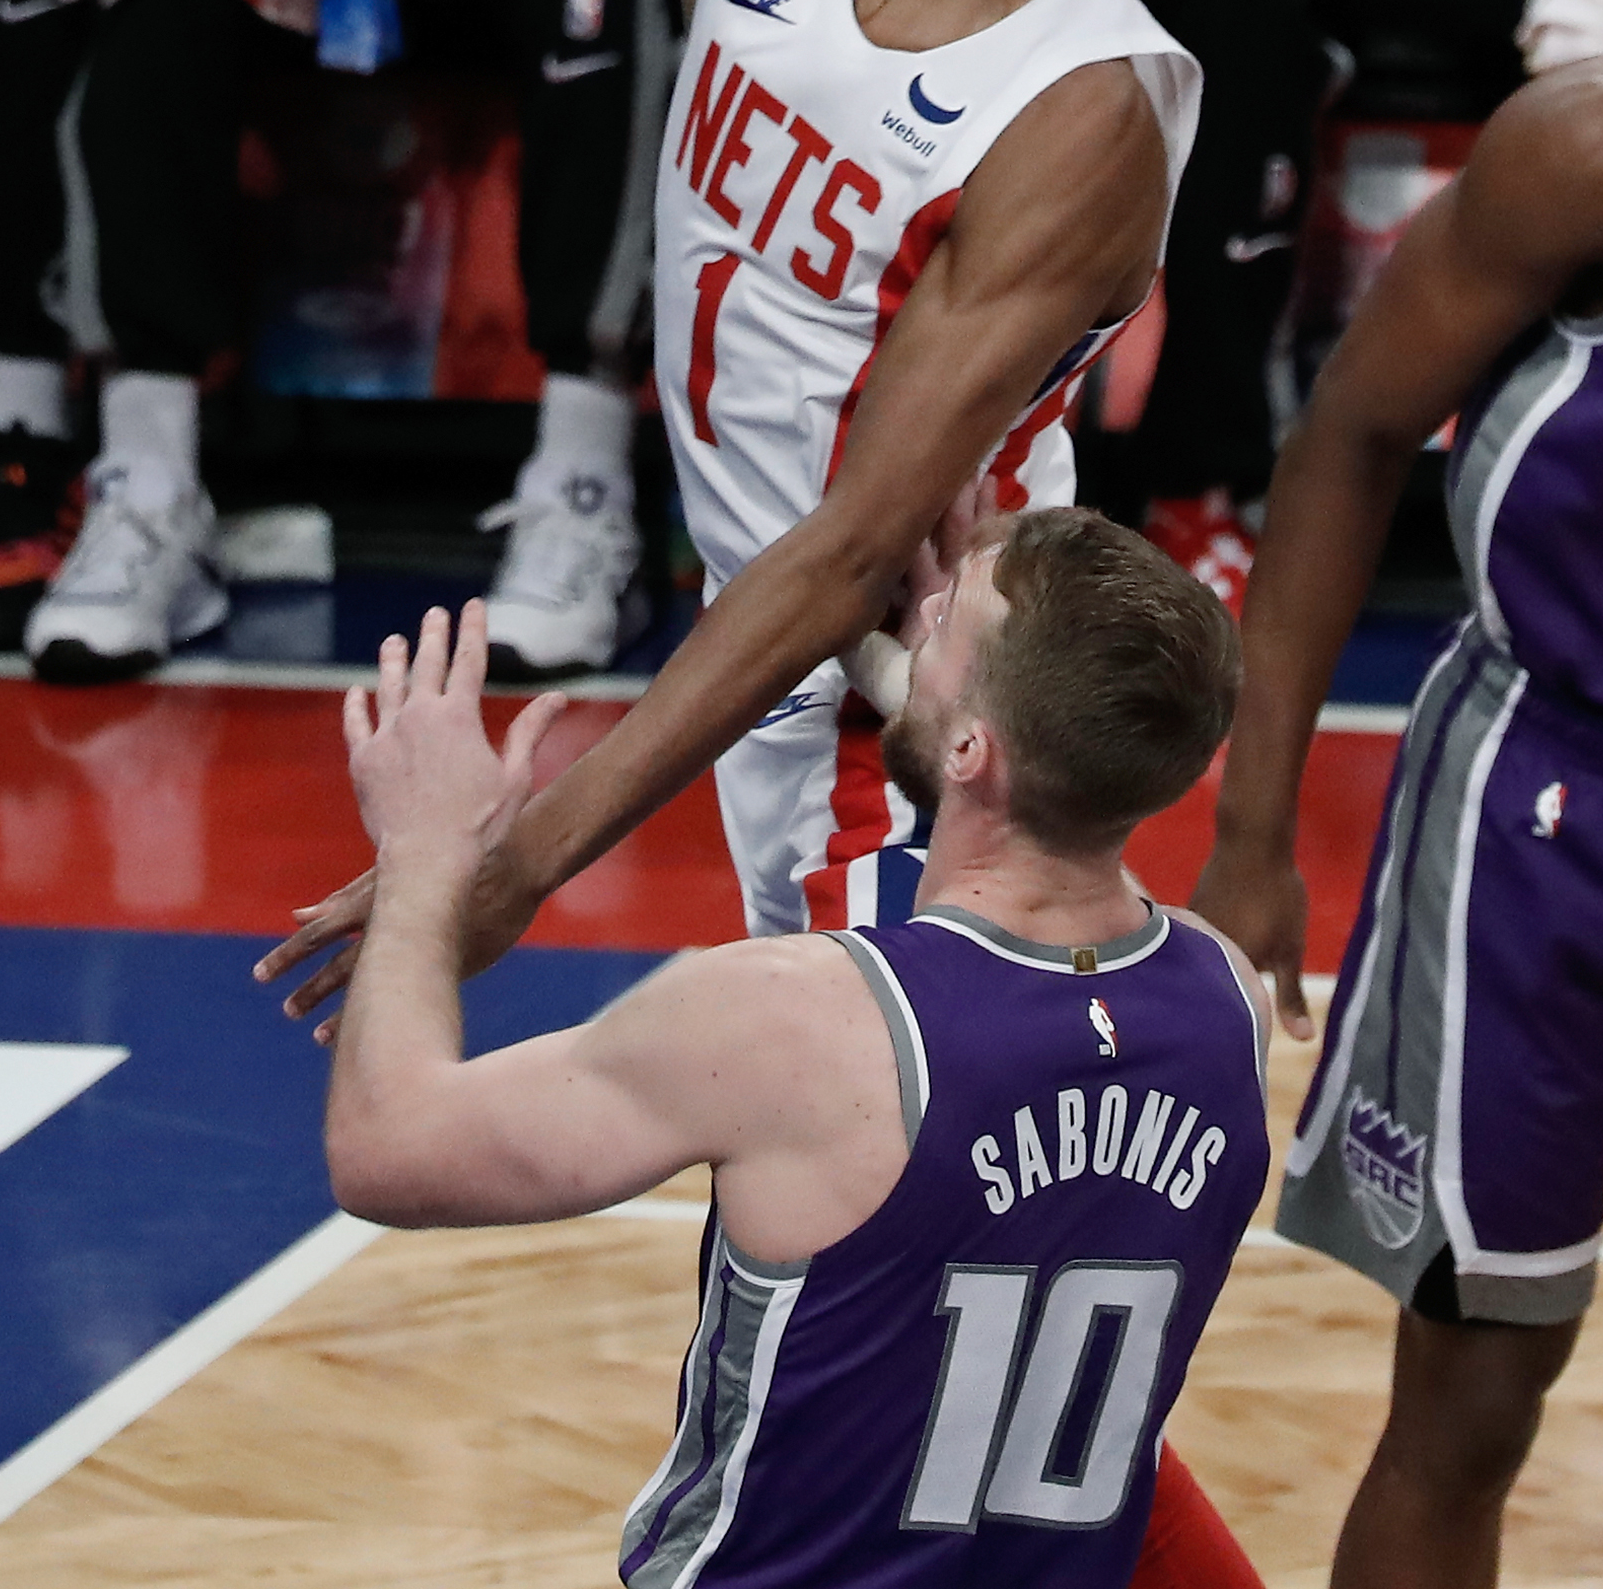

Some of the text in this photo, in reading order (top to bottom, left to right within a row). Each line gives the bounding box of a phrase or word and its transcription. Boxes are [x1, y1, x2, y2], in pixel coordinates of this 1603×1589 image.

[675, 40, 883, 303] NETS
[881, 109, 937, 158] Webull
[686, 250, 742, 447] 1
[970, 1084, 1229, 1217] SABONIS
[899, 1258, 1185, 1536] 10
